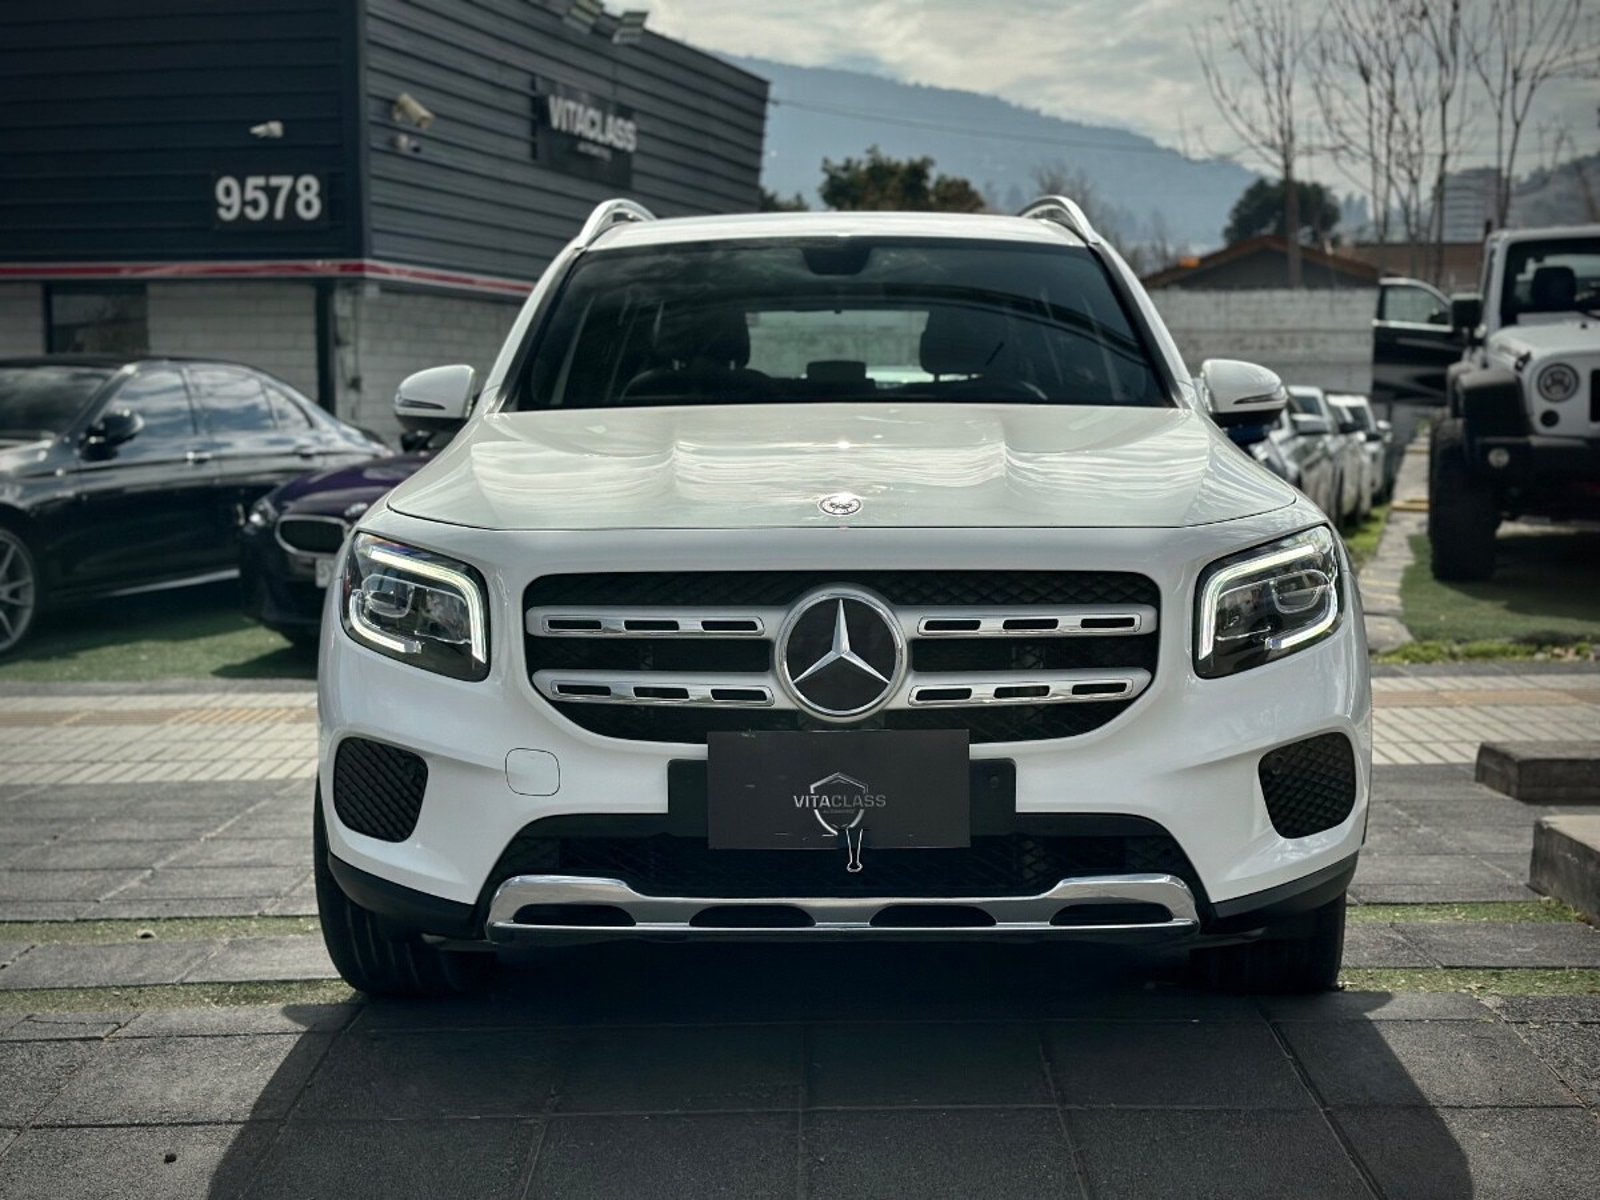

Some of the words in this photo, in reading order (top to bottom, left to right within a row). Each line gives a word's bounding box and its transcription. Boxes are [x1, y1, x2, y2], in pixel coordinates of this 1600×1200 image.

[548, 94, 637, 153] VITACLASS
[215, 174, 322, 221] 9578
[793, 794, 887, 808] VITACLASS
